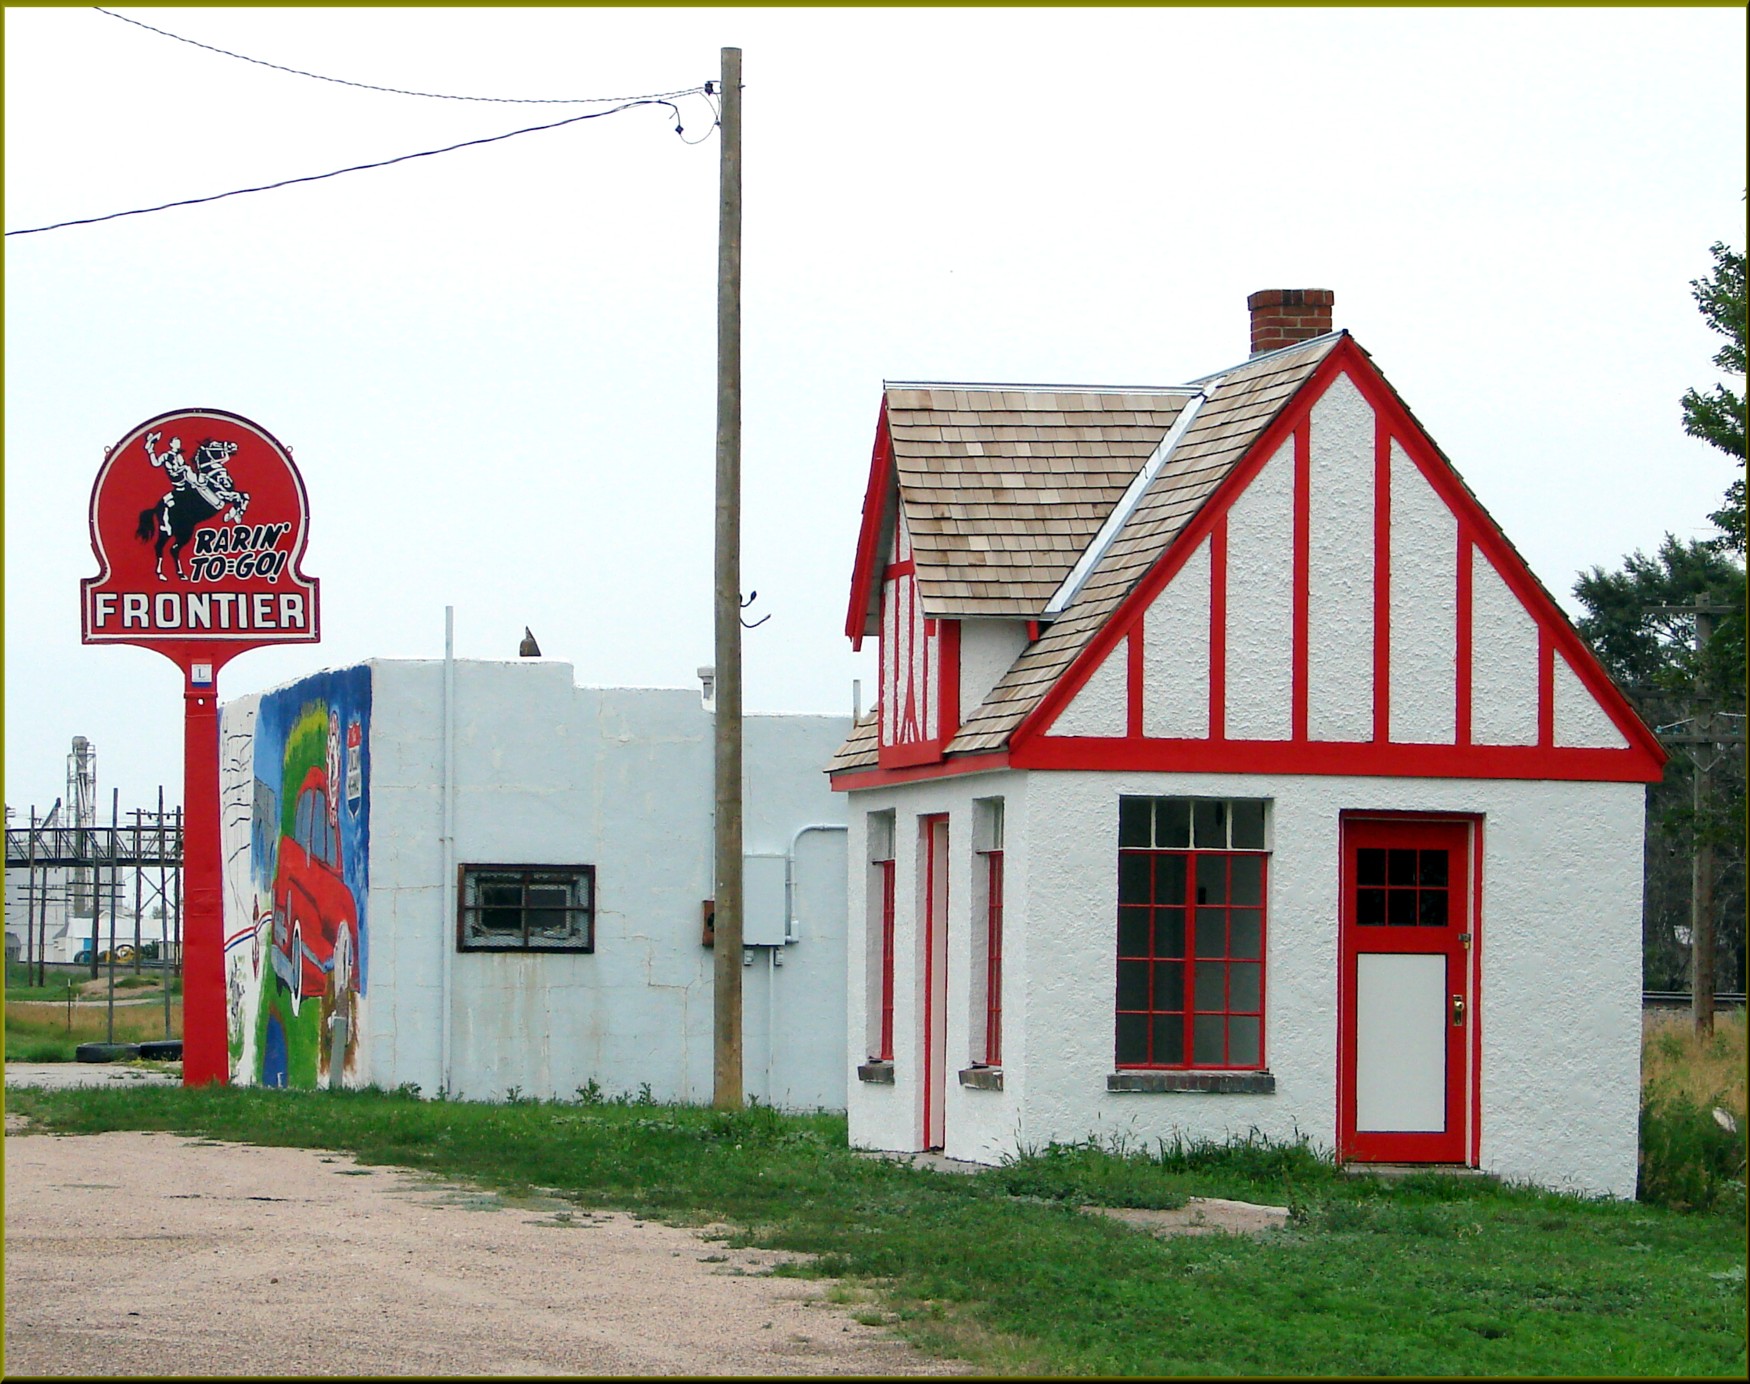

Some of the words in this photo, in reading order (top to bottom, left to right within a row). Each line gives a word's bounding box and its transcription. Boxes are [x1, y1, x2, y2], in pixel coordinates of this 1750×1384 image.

[195, 523, 291, 554] RARIN'
[95, 593, 305, 628] FRONTIER
[197, 668, 207, 679] L
